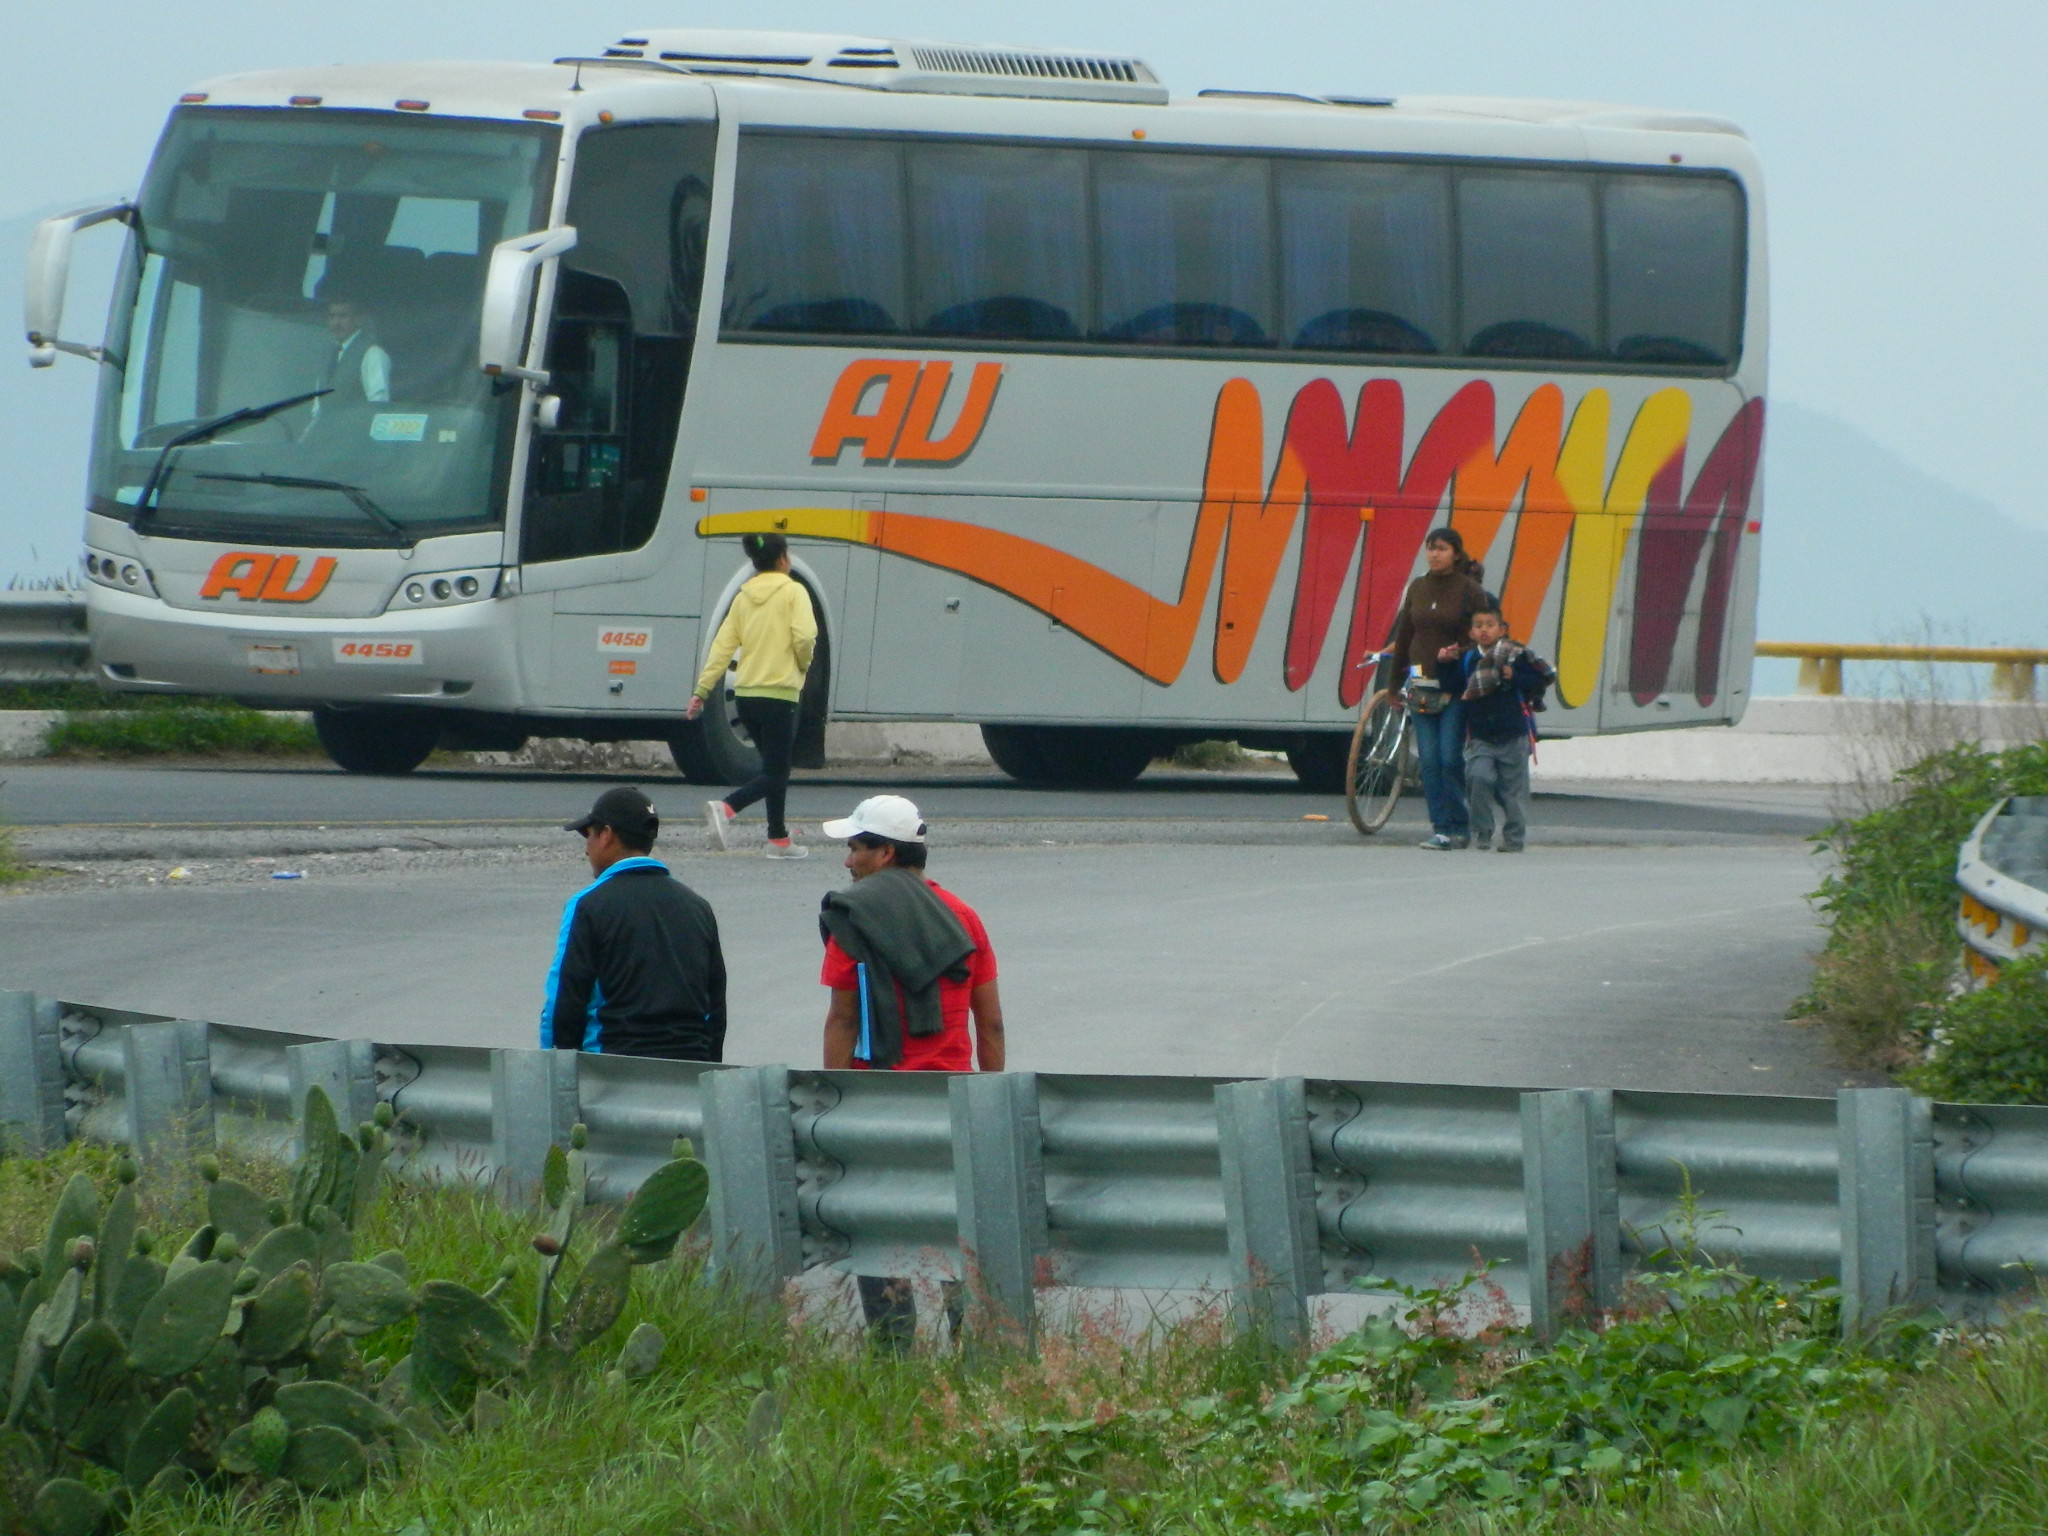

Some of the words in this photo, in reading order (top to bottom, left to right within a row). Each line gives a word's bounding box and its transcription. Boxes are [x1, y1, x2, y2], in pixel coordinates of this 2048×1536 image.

[809, 359, 1003, 469] AU
[199, 552, 338, 603] AU
[341, 643, 414, 658] 4458
[601, 631, 648, 647] 4458
